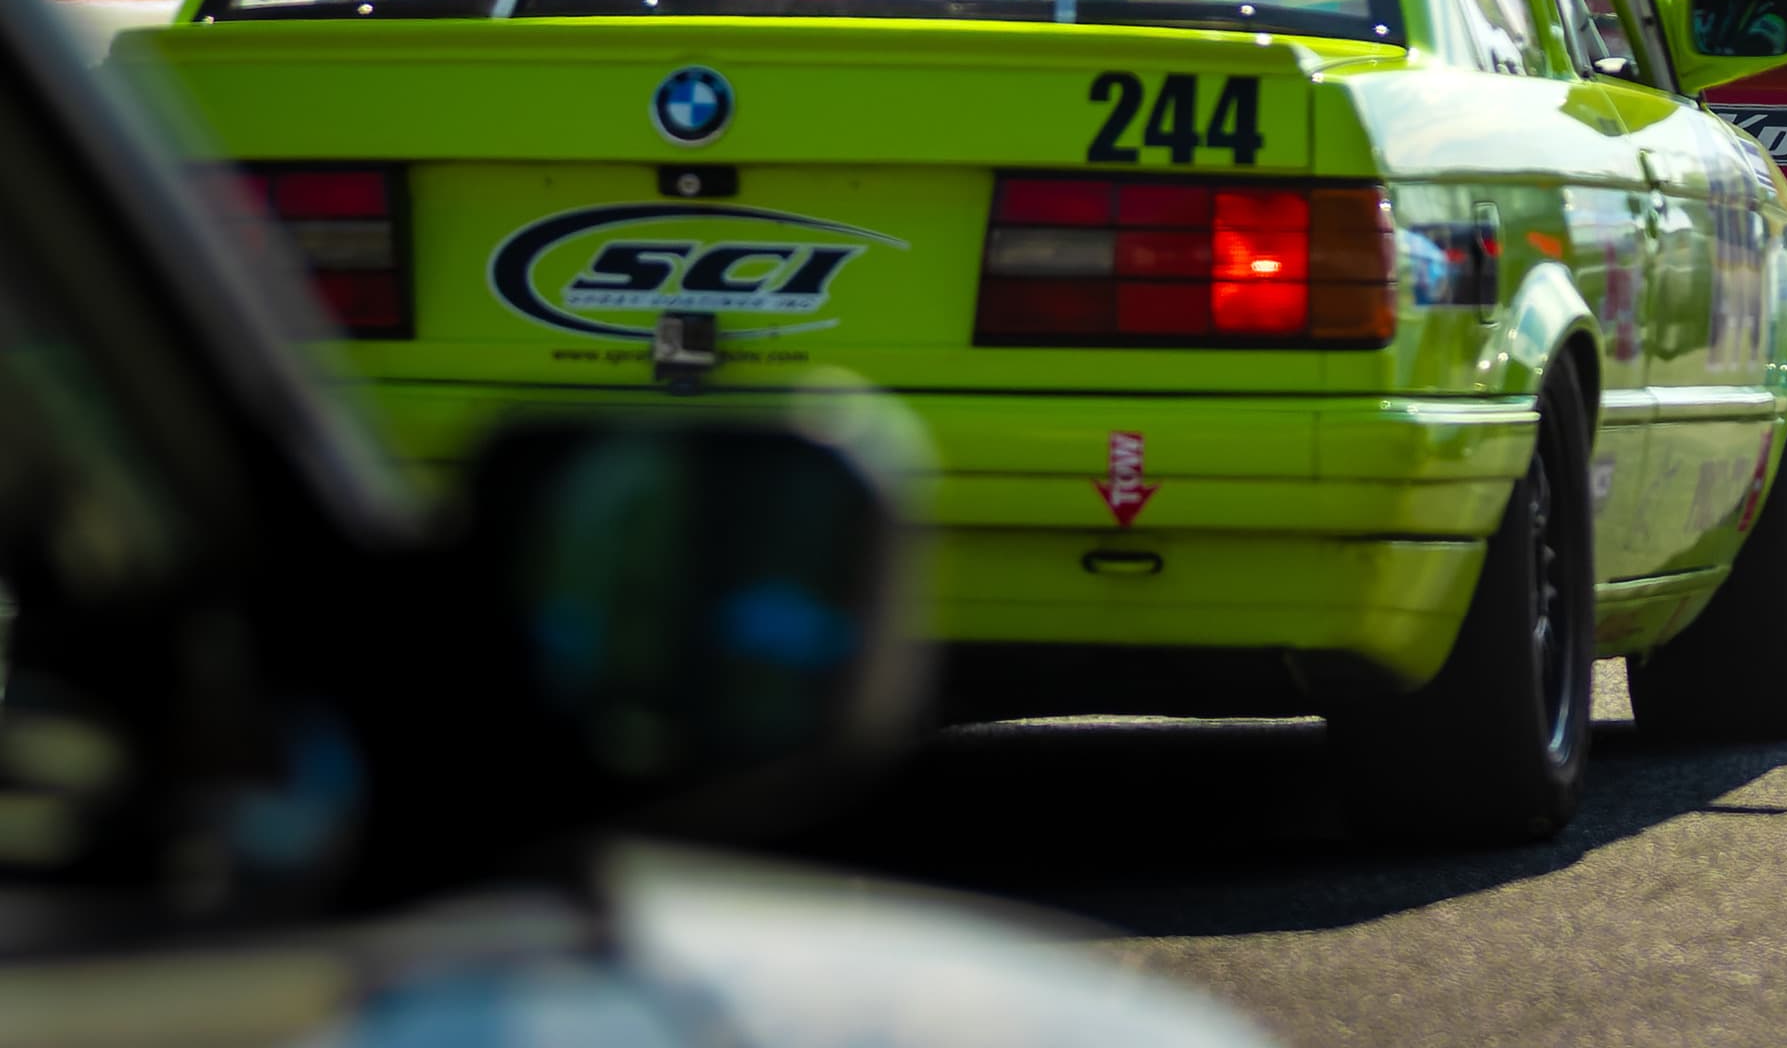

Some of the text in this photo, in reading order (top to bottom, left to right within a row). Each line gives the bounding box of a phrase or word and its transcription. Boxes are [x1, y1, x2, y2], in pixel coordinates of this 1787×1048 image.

[1087, 70, 1264, 165] 244
[565, 242, 868, 293] SCI
[1110, 432, 1145, 507] TOW
